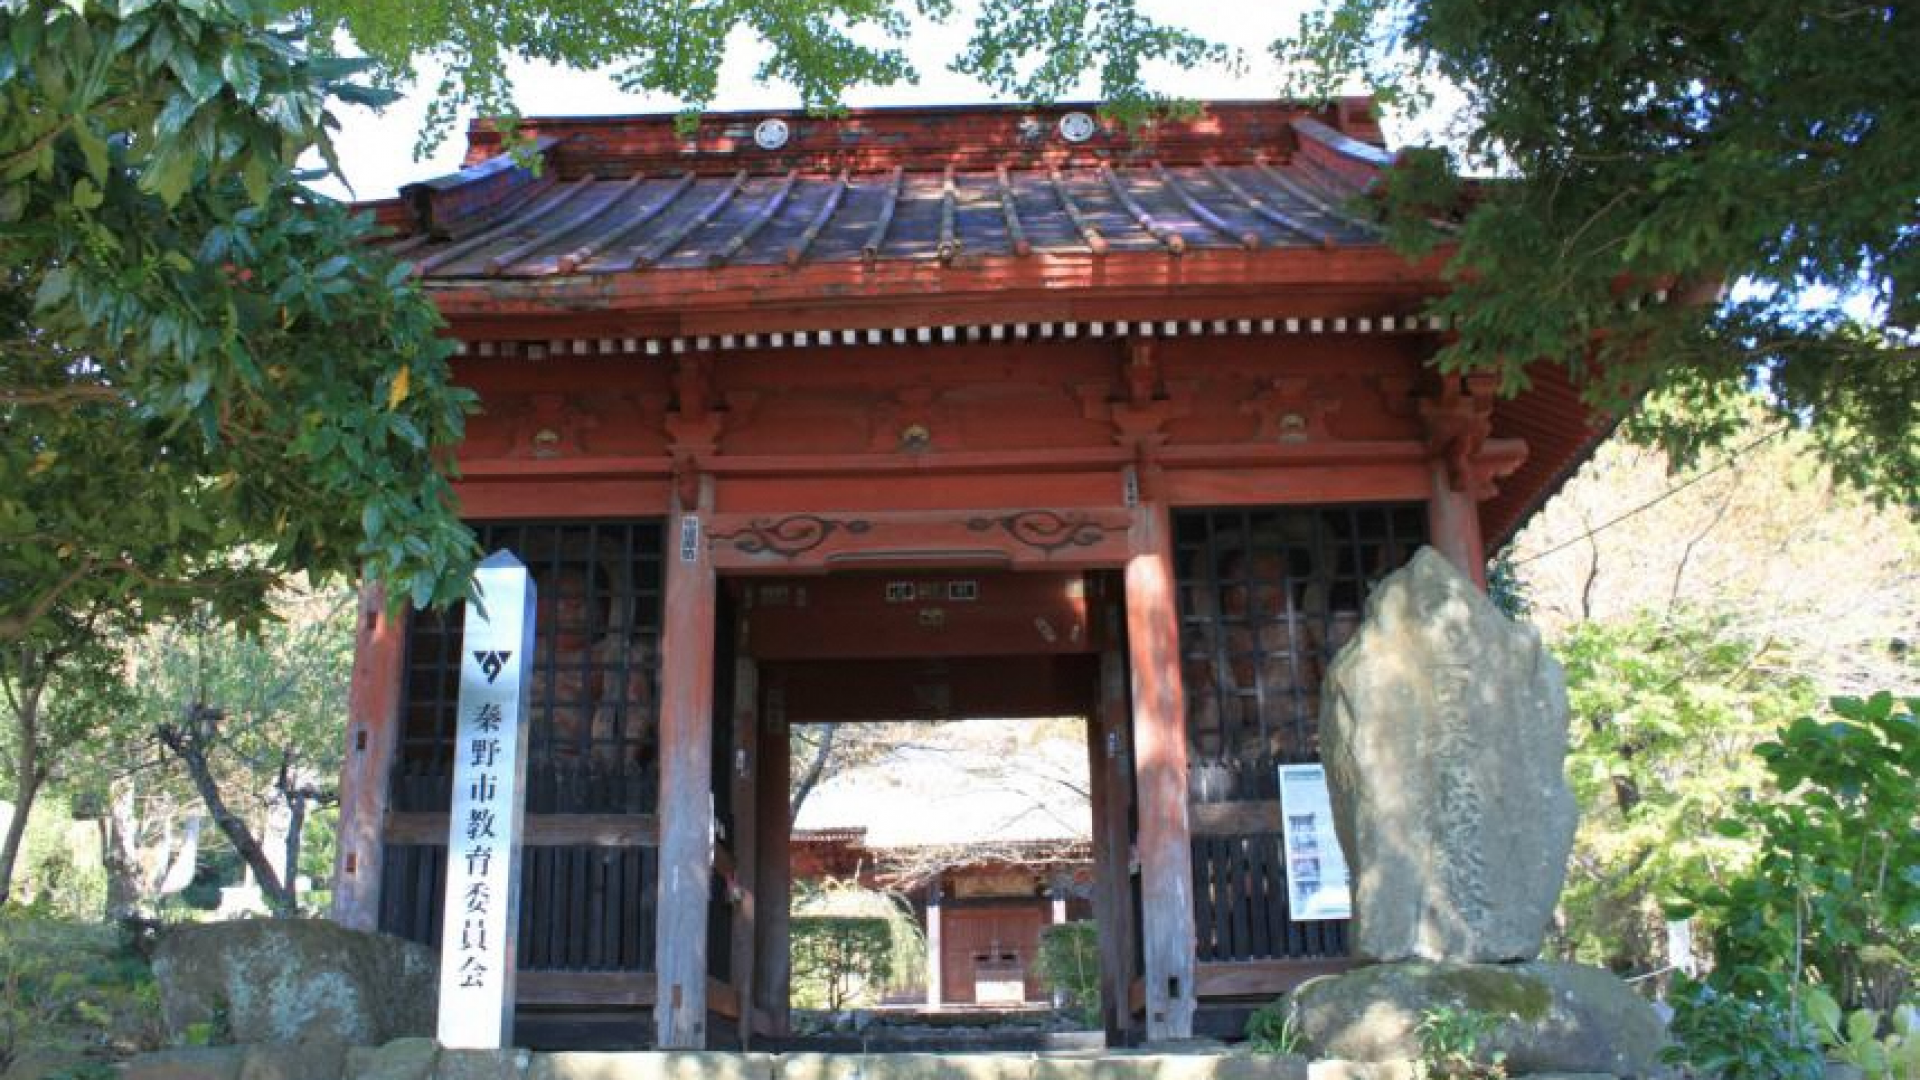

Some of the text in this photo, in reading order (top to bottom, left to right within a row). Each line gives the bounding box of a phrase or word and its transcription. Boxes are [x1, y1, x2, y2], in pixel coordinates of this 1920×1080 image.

[459, 703, 502, 989] 秦野市教育委員会
